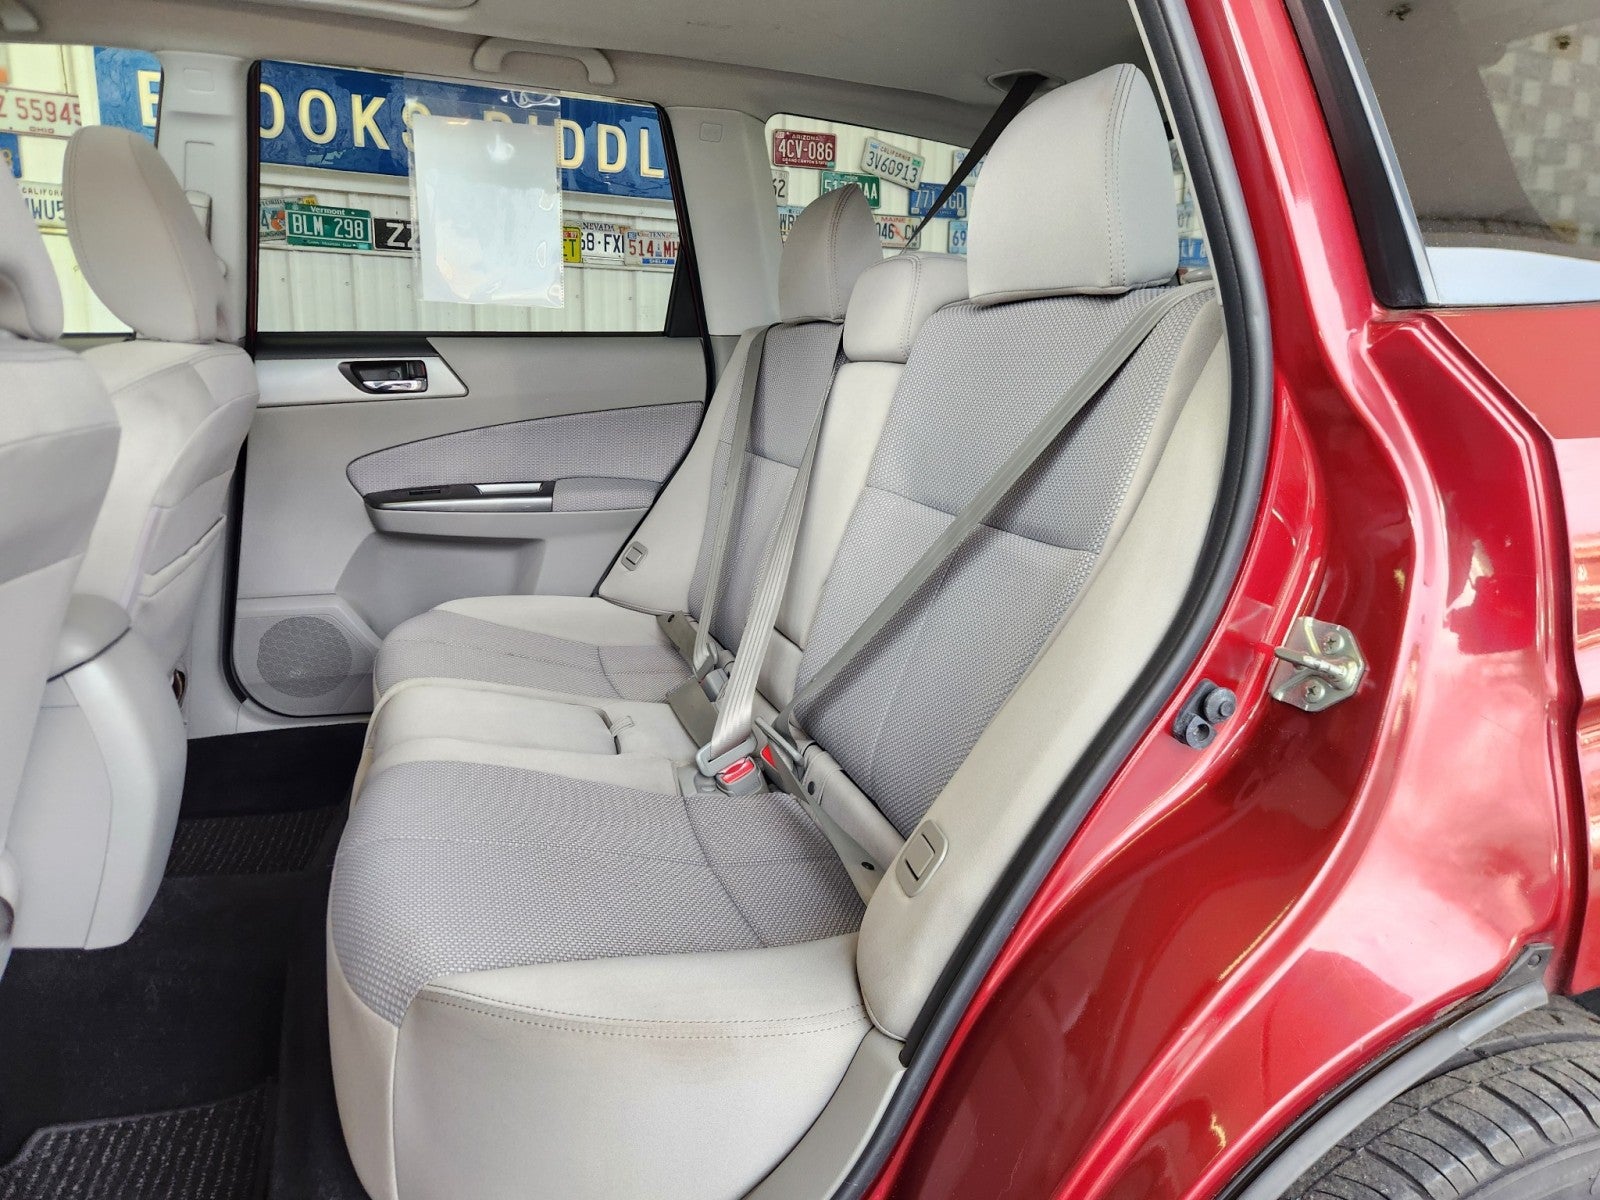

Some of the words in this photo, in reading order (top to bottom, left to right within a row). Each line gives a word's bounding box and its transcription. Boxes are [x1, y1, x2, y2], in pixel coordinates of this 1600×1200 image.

[29, 126, 54, 134] OHIO
[778, 138, 833, 161] 4CV-086
[866, 151, 919, 184] 3V60913
[22, 187, 63, 197] CALIFOR
[943, 192, 966, 210] GD
[311, 205, 346, 216] Vermont
[292, 213, 325, 237] BLM
[333, 217, 365, 240] 298
[582, 221, 615, 232] NEVADA
[881, 216, 906, 224] MAINE
[628, 239, 654, 257] 514
